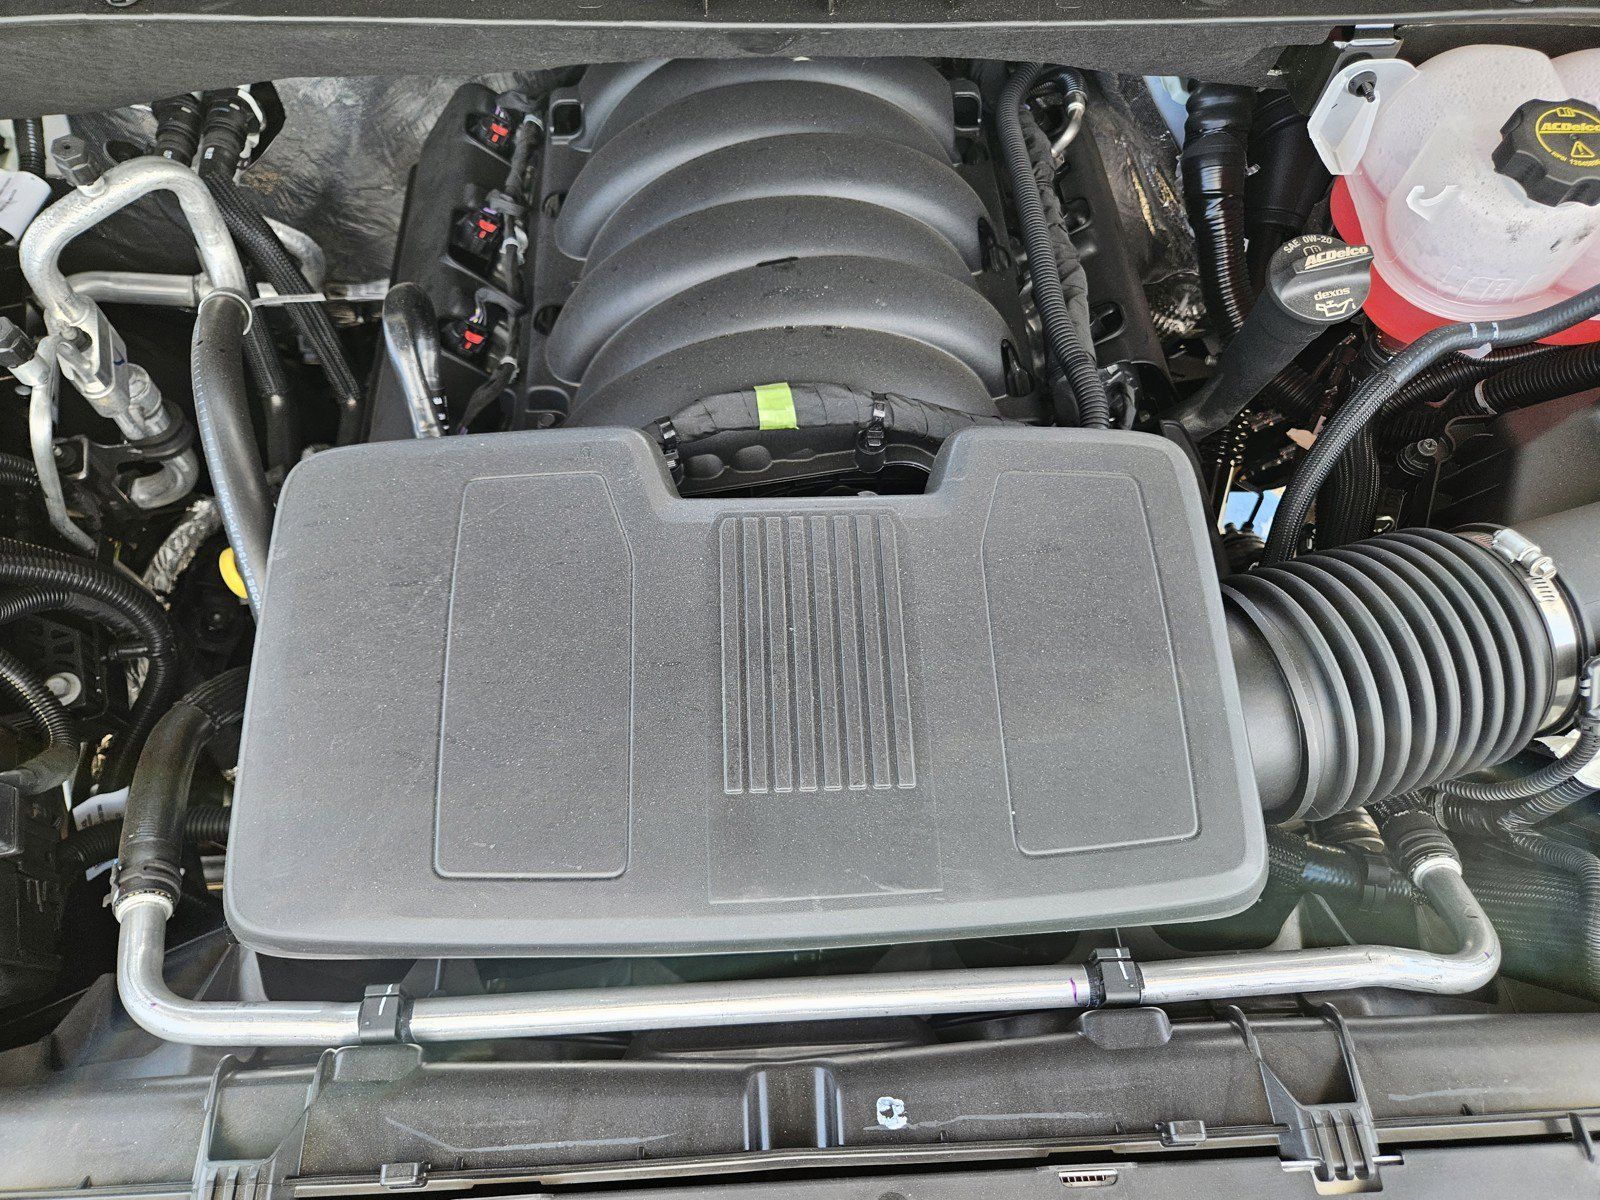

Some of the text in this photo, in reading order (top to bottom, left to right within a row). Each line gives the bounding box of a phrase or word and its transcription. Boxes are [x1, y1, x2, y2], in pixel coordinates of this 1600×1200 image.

[1540, 122, 1600, 131] ACDelco
[1283, 235, 1333, 254] SAE 0W-20
[1305, 245, 1369, 269] ACDelco
[1314, 287, 1351, 301] dexos
